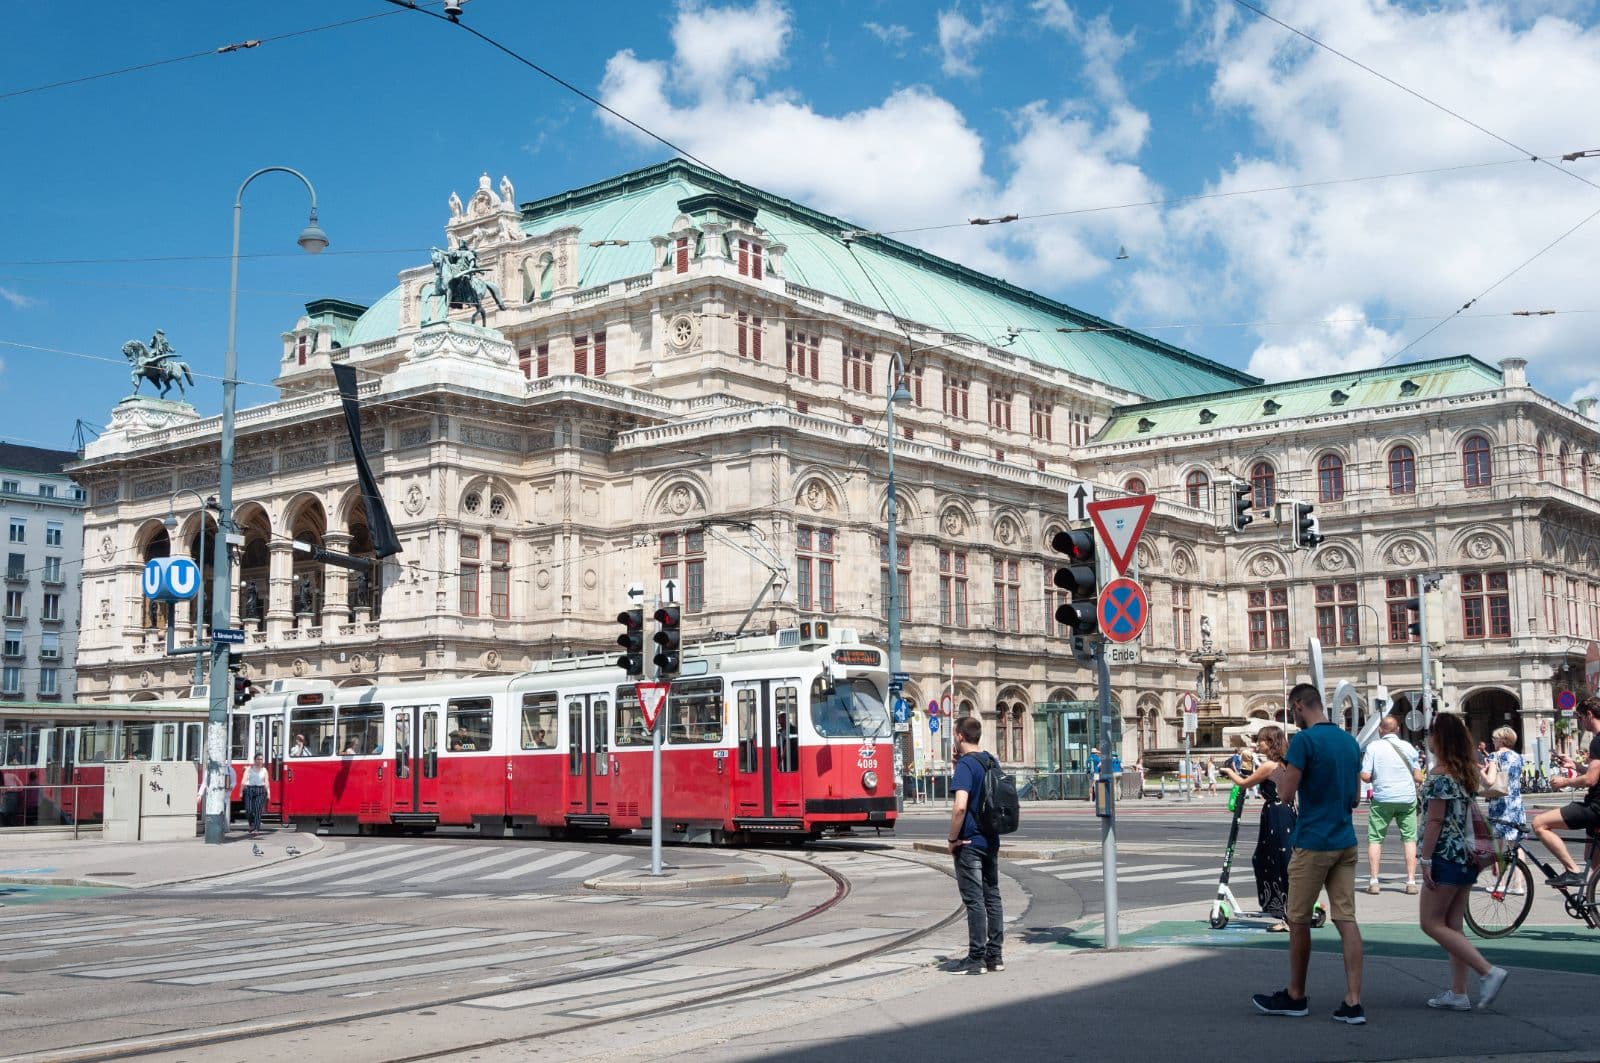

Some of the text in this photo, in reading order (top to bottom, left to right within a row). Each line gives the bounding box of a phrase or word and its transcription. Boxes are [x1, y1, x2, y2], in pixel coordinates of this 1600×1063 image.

[145, 566, 160, 595] U
[171, 566, 195, 594] U
[804, 624, 809, 637] 1
[817, 623, 824, 639] 1
[1112, 648, 1135, 661] Ende
[857, 759, 878, 769] 4089
